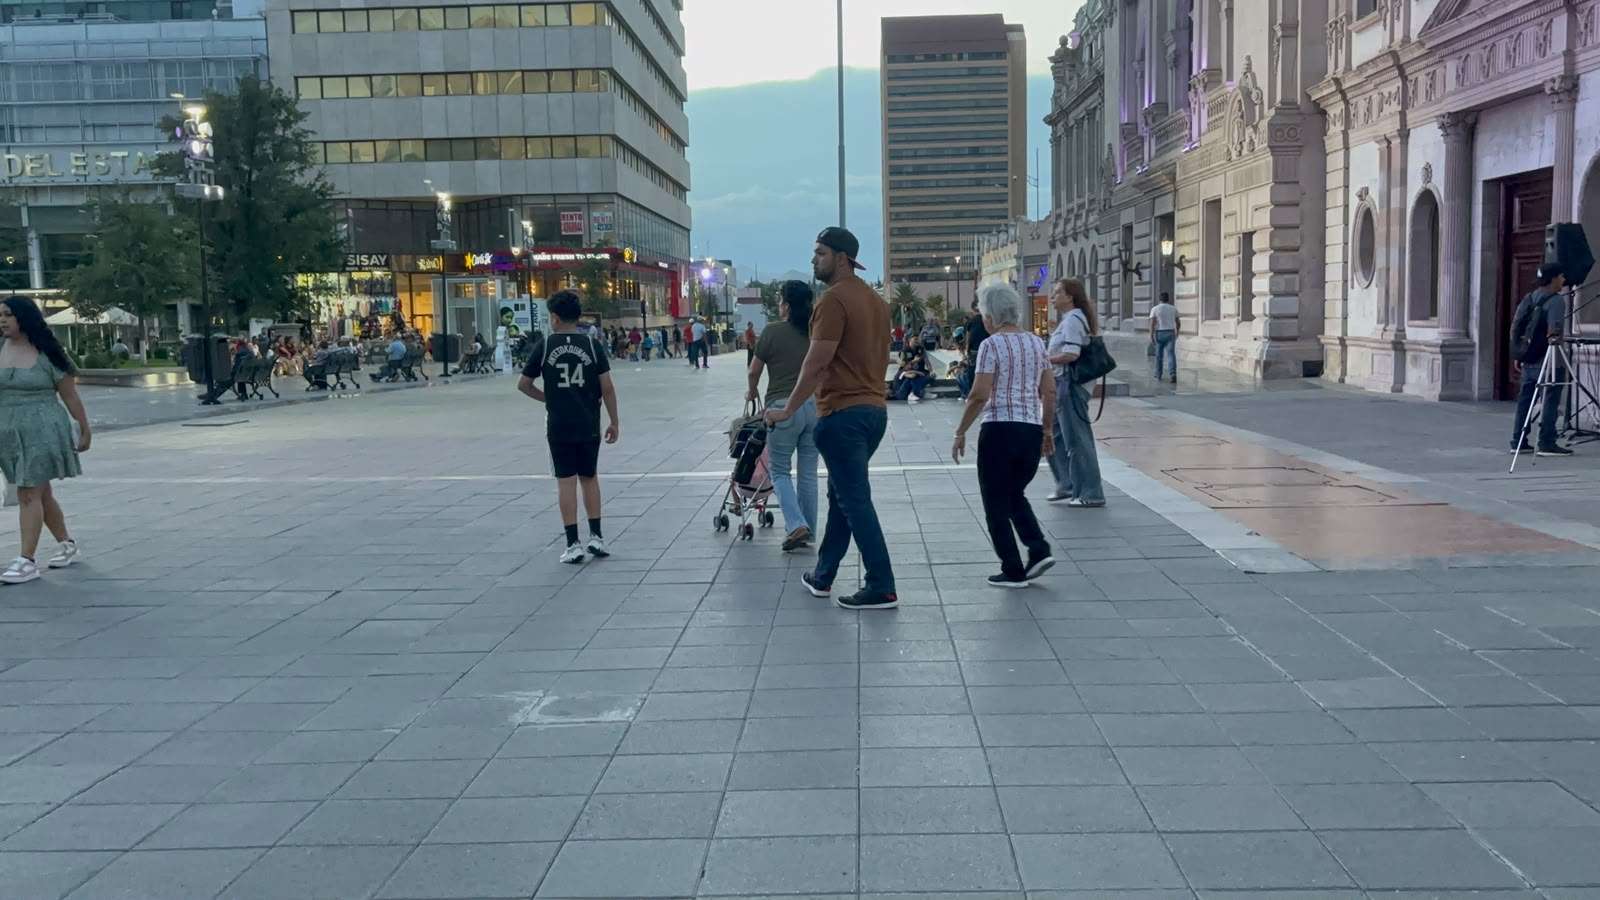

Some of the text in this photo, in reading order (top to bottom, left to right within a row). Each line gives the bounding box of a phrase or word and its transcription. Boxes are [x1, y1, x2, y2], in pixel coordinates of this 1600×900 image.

[3, 151, 156, 178] DEL ESTA
[346, 254, 388, 266] SISAY
[556, 363, 585, 388] 34
